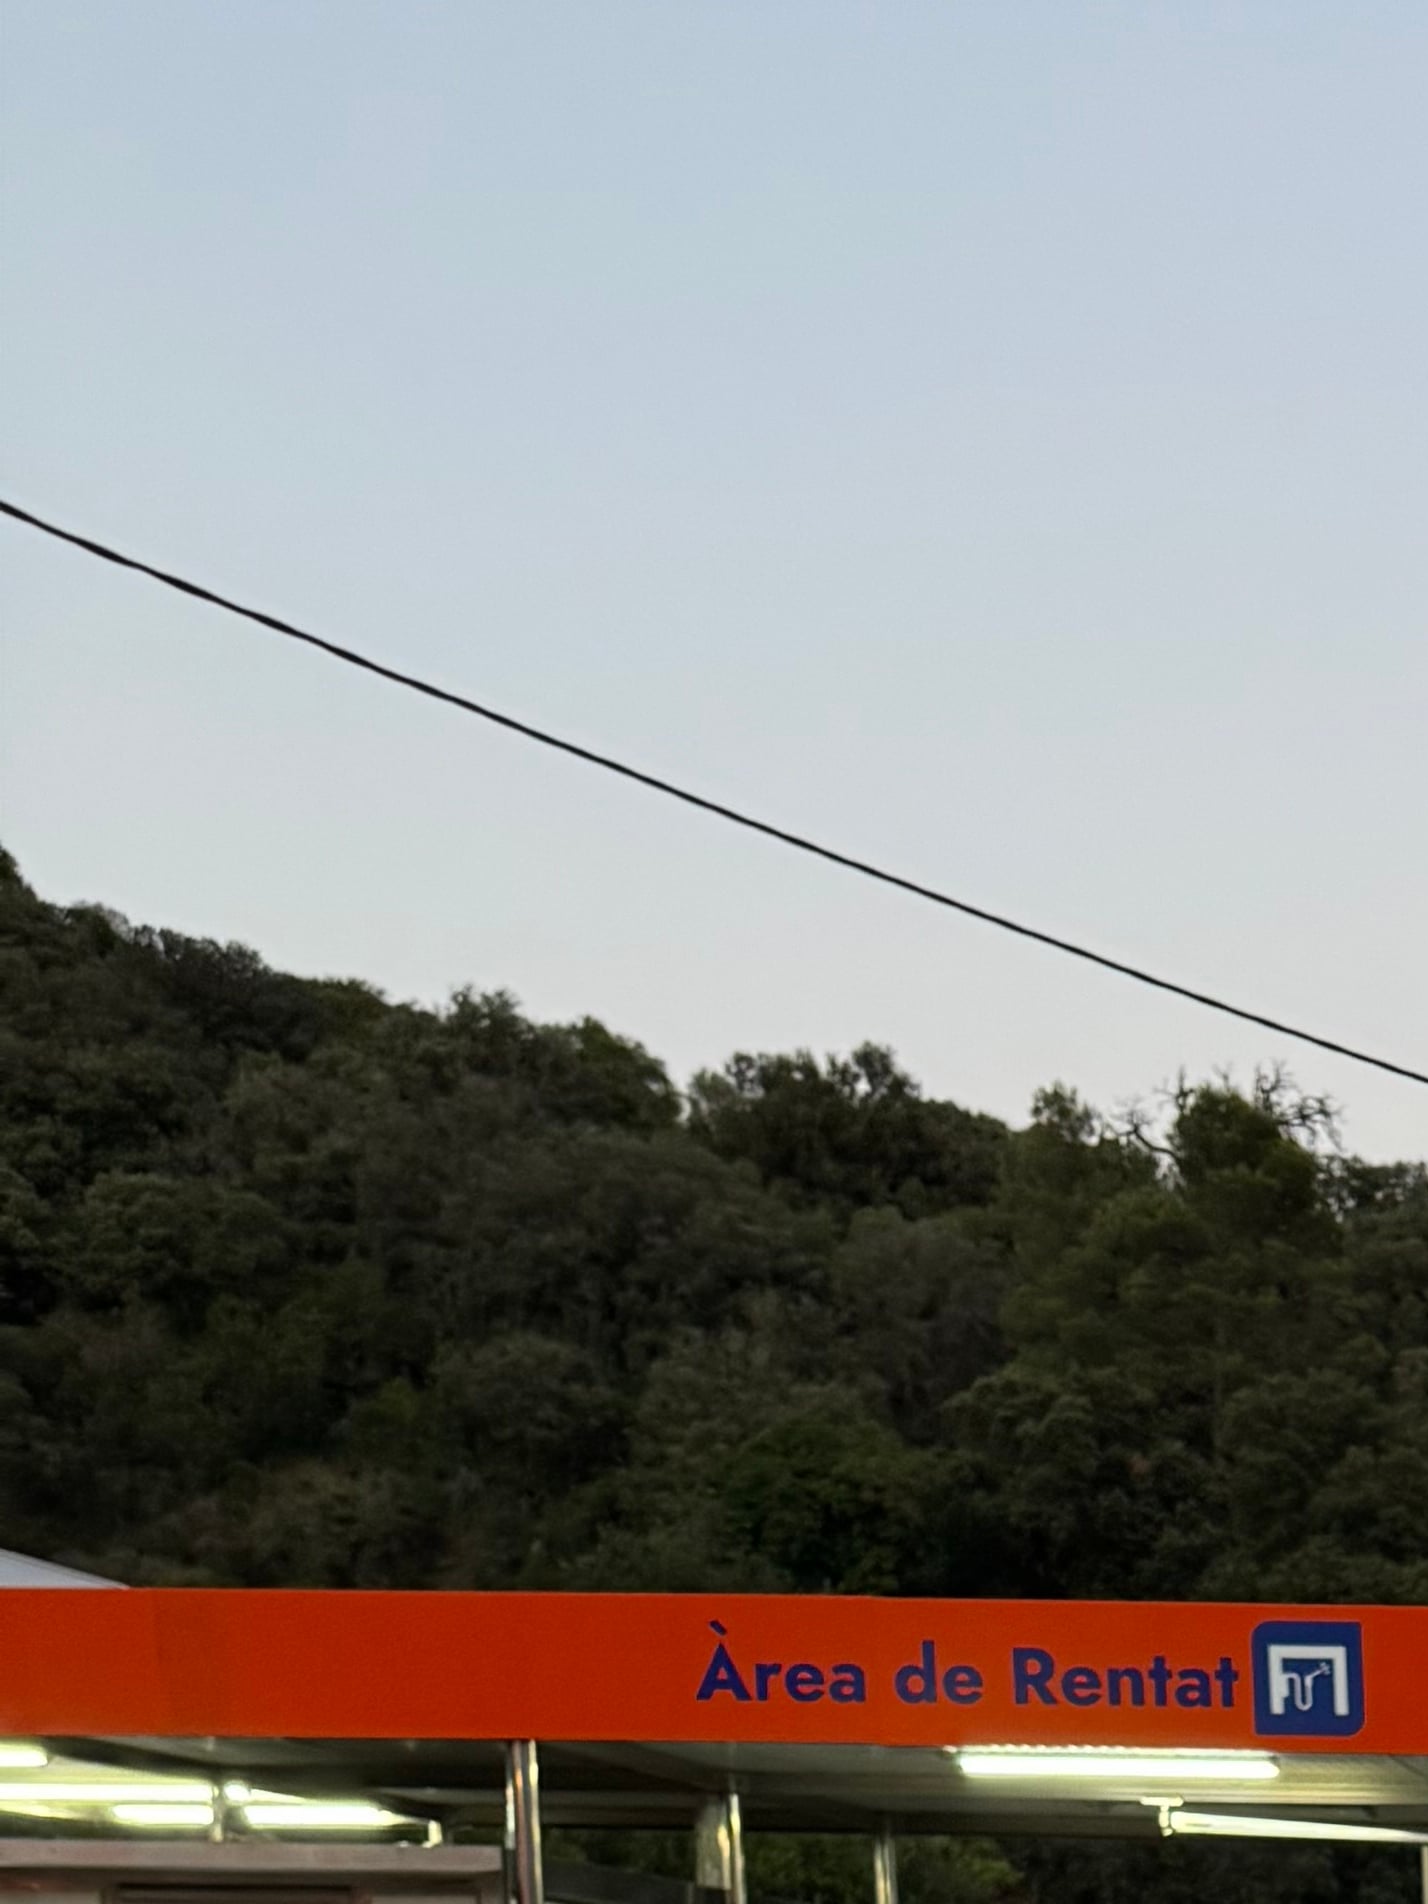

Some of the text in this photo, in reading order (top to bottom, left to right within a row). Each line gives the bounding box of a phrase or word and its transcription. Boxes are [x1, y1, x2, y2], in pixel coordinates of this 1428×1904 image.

[697, 1620, 1238, 1707] Àrea de Rentat
